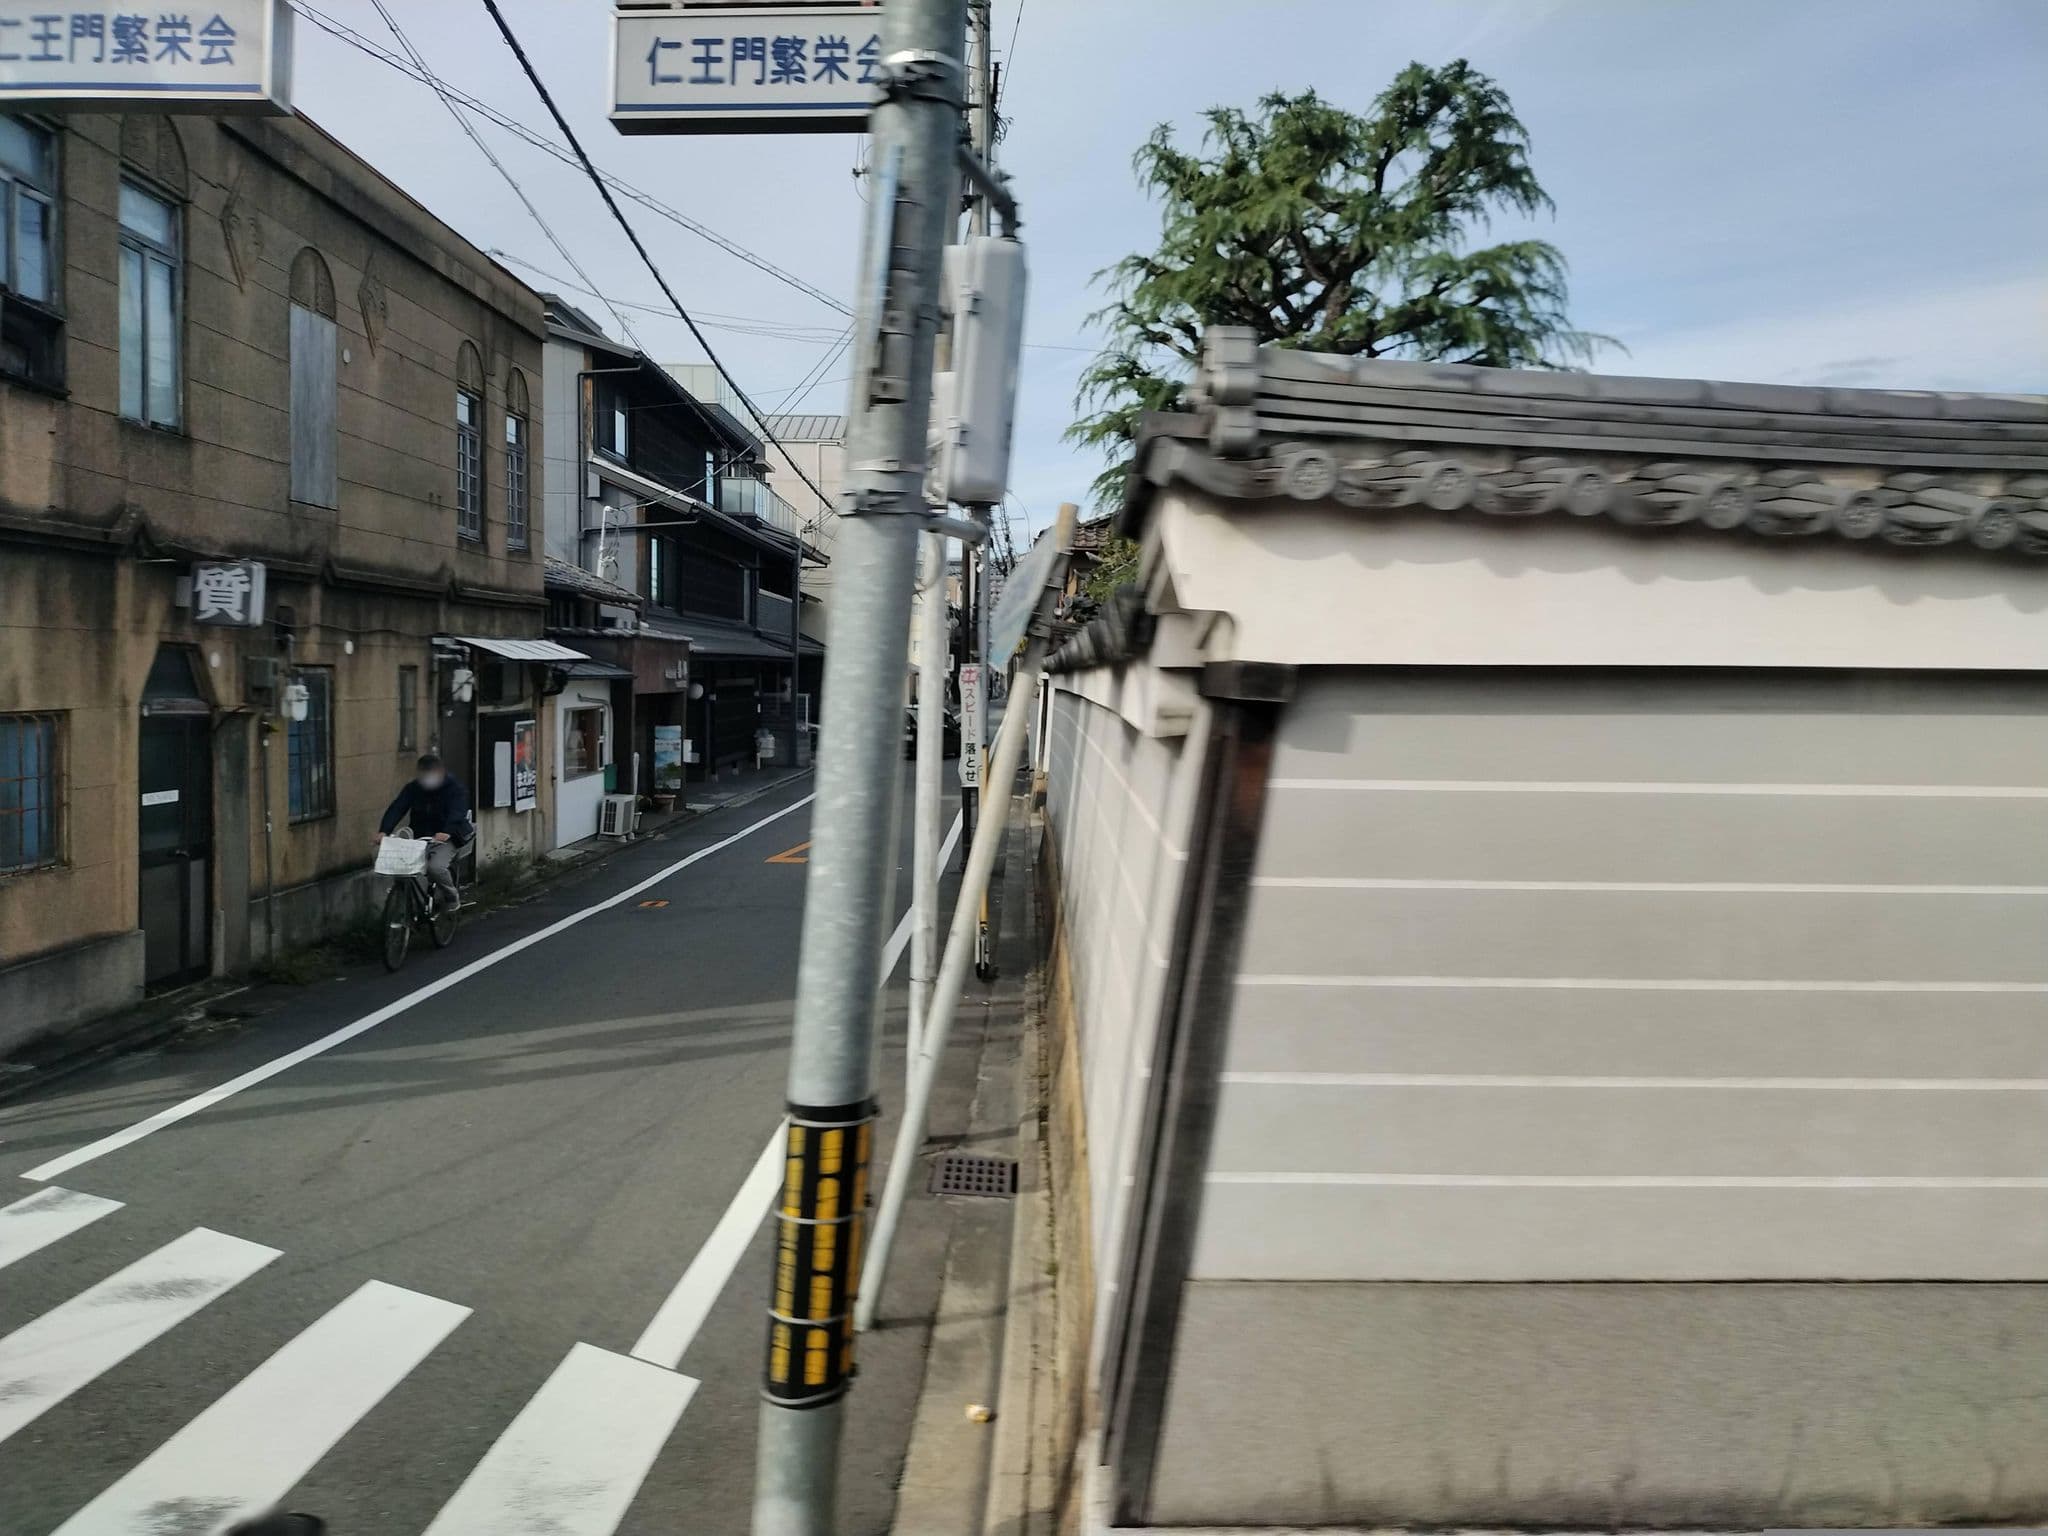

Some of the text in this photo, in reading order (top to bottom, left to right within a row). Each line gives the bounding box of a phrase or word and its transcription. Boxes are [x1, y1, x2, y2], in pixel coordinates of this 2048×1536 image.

[647, 34, 882, 86] 仁王門繁栄会
[192, 567, 251, 622] 質
